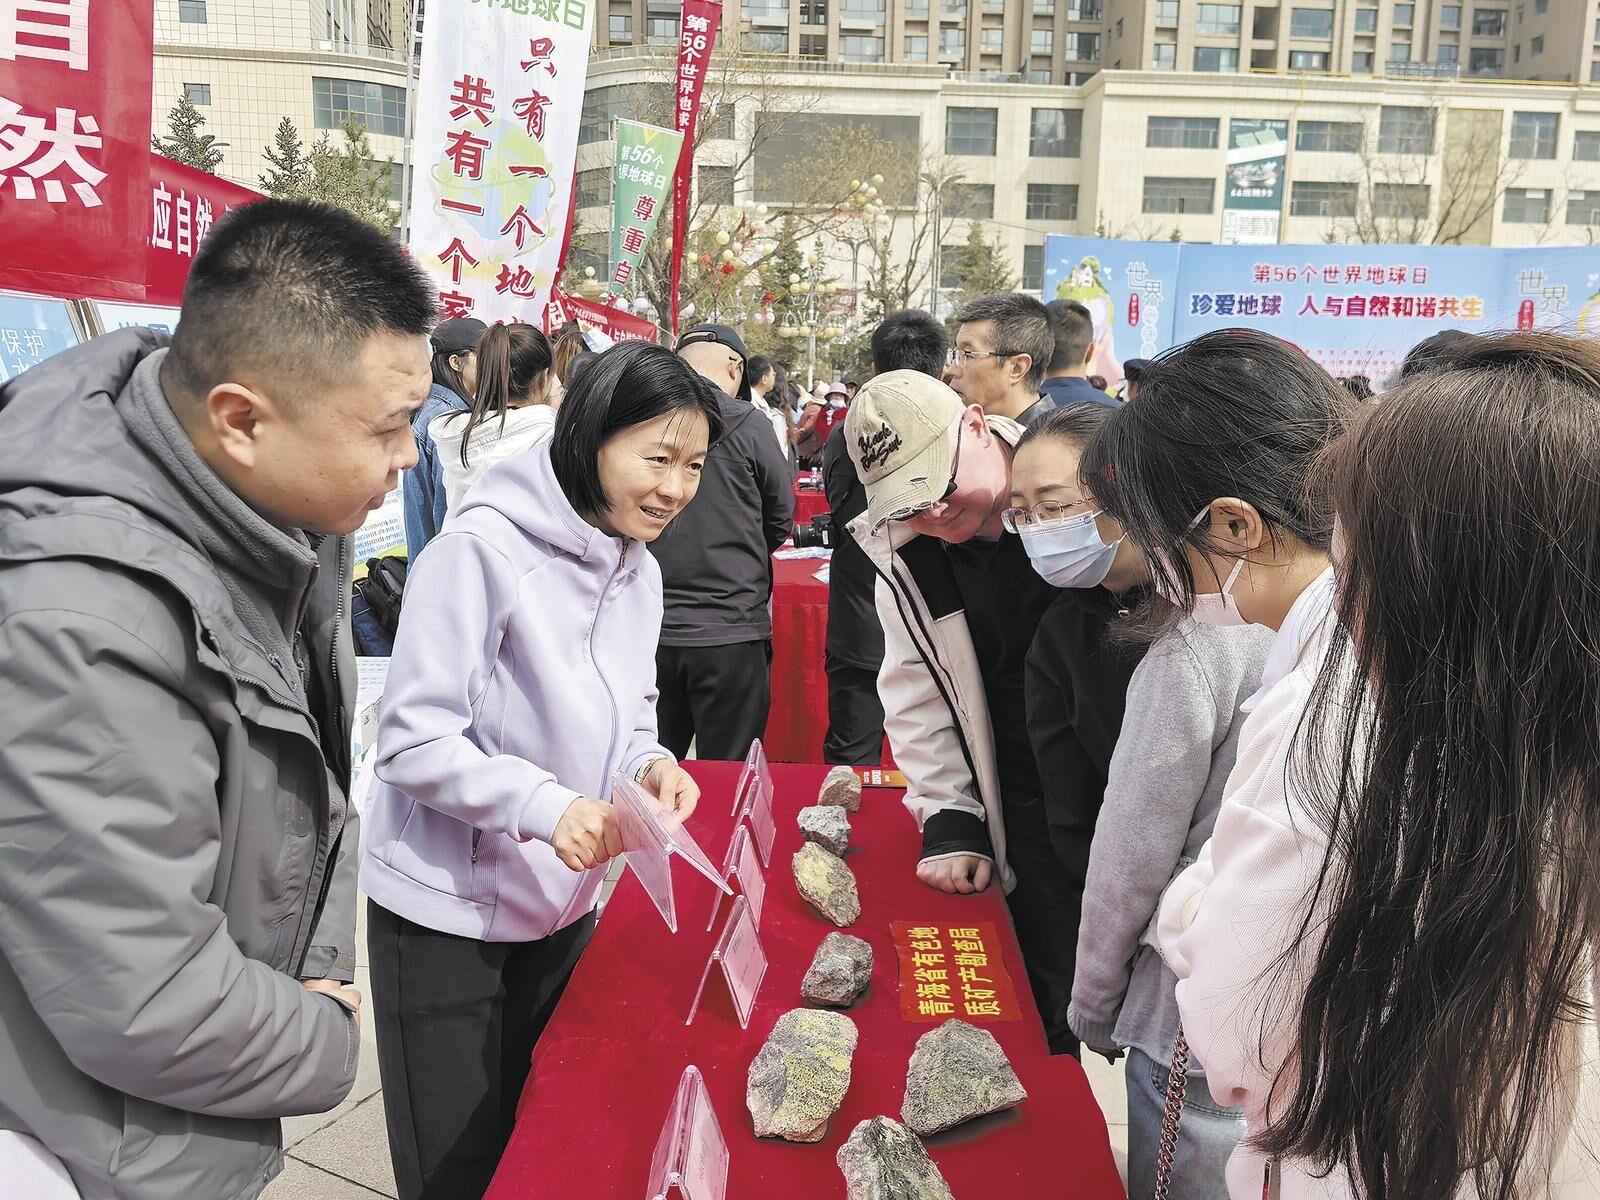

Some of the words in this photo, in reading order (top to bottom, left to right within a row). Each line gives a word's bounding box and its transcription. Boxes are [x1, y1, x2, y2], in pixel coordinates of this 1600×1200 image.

[472, 0, 585, 31] 地球日
[621, 144, 664, 170] 第56个
[496, 37, 560, 325] 只有一个地
[147, 181, 213, 257] 应自然
[1253, 264, 1429, 285] 第56个世界地球日
[1190, 293, 1283, 316] 珍爱地球
[1298, 294, 1484, 319] 人与自然和谐共生
[1, 328, 46, 356] 保护
[907, 926, 955, 1016] 青海省有色地
[948, 927, 1002, 1016] 质矿产勘查局
